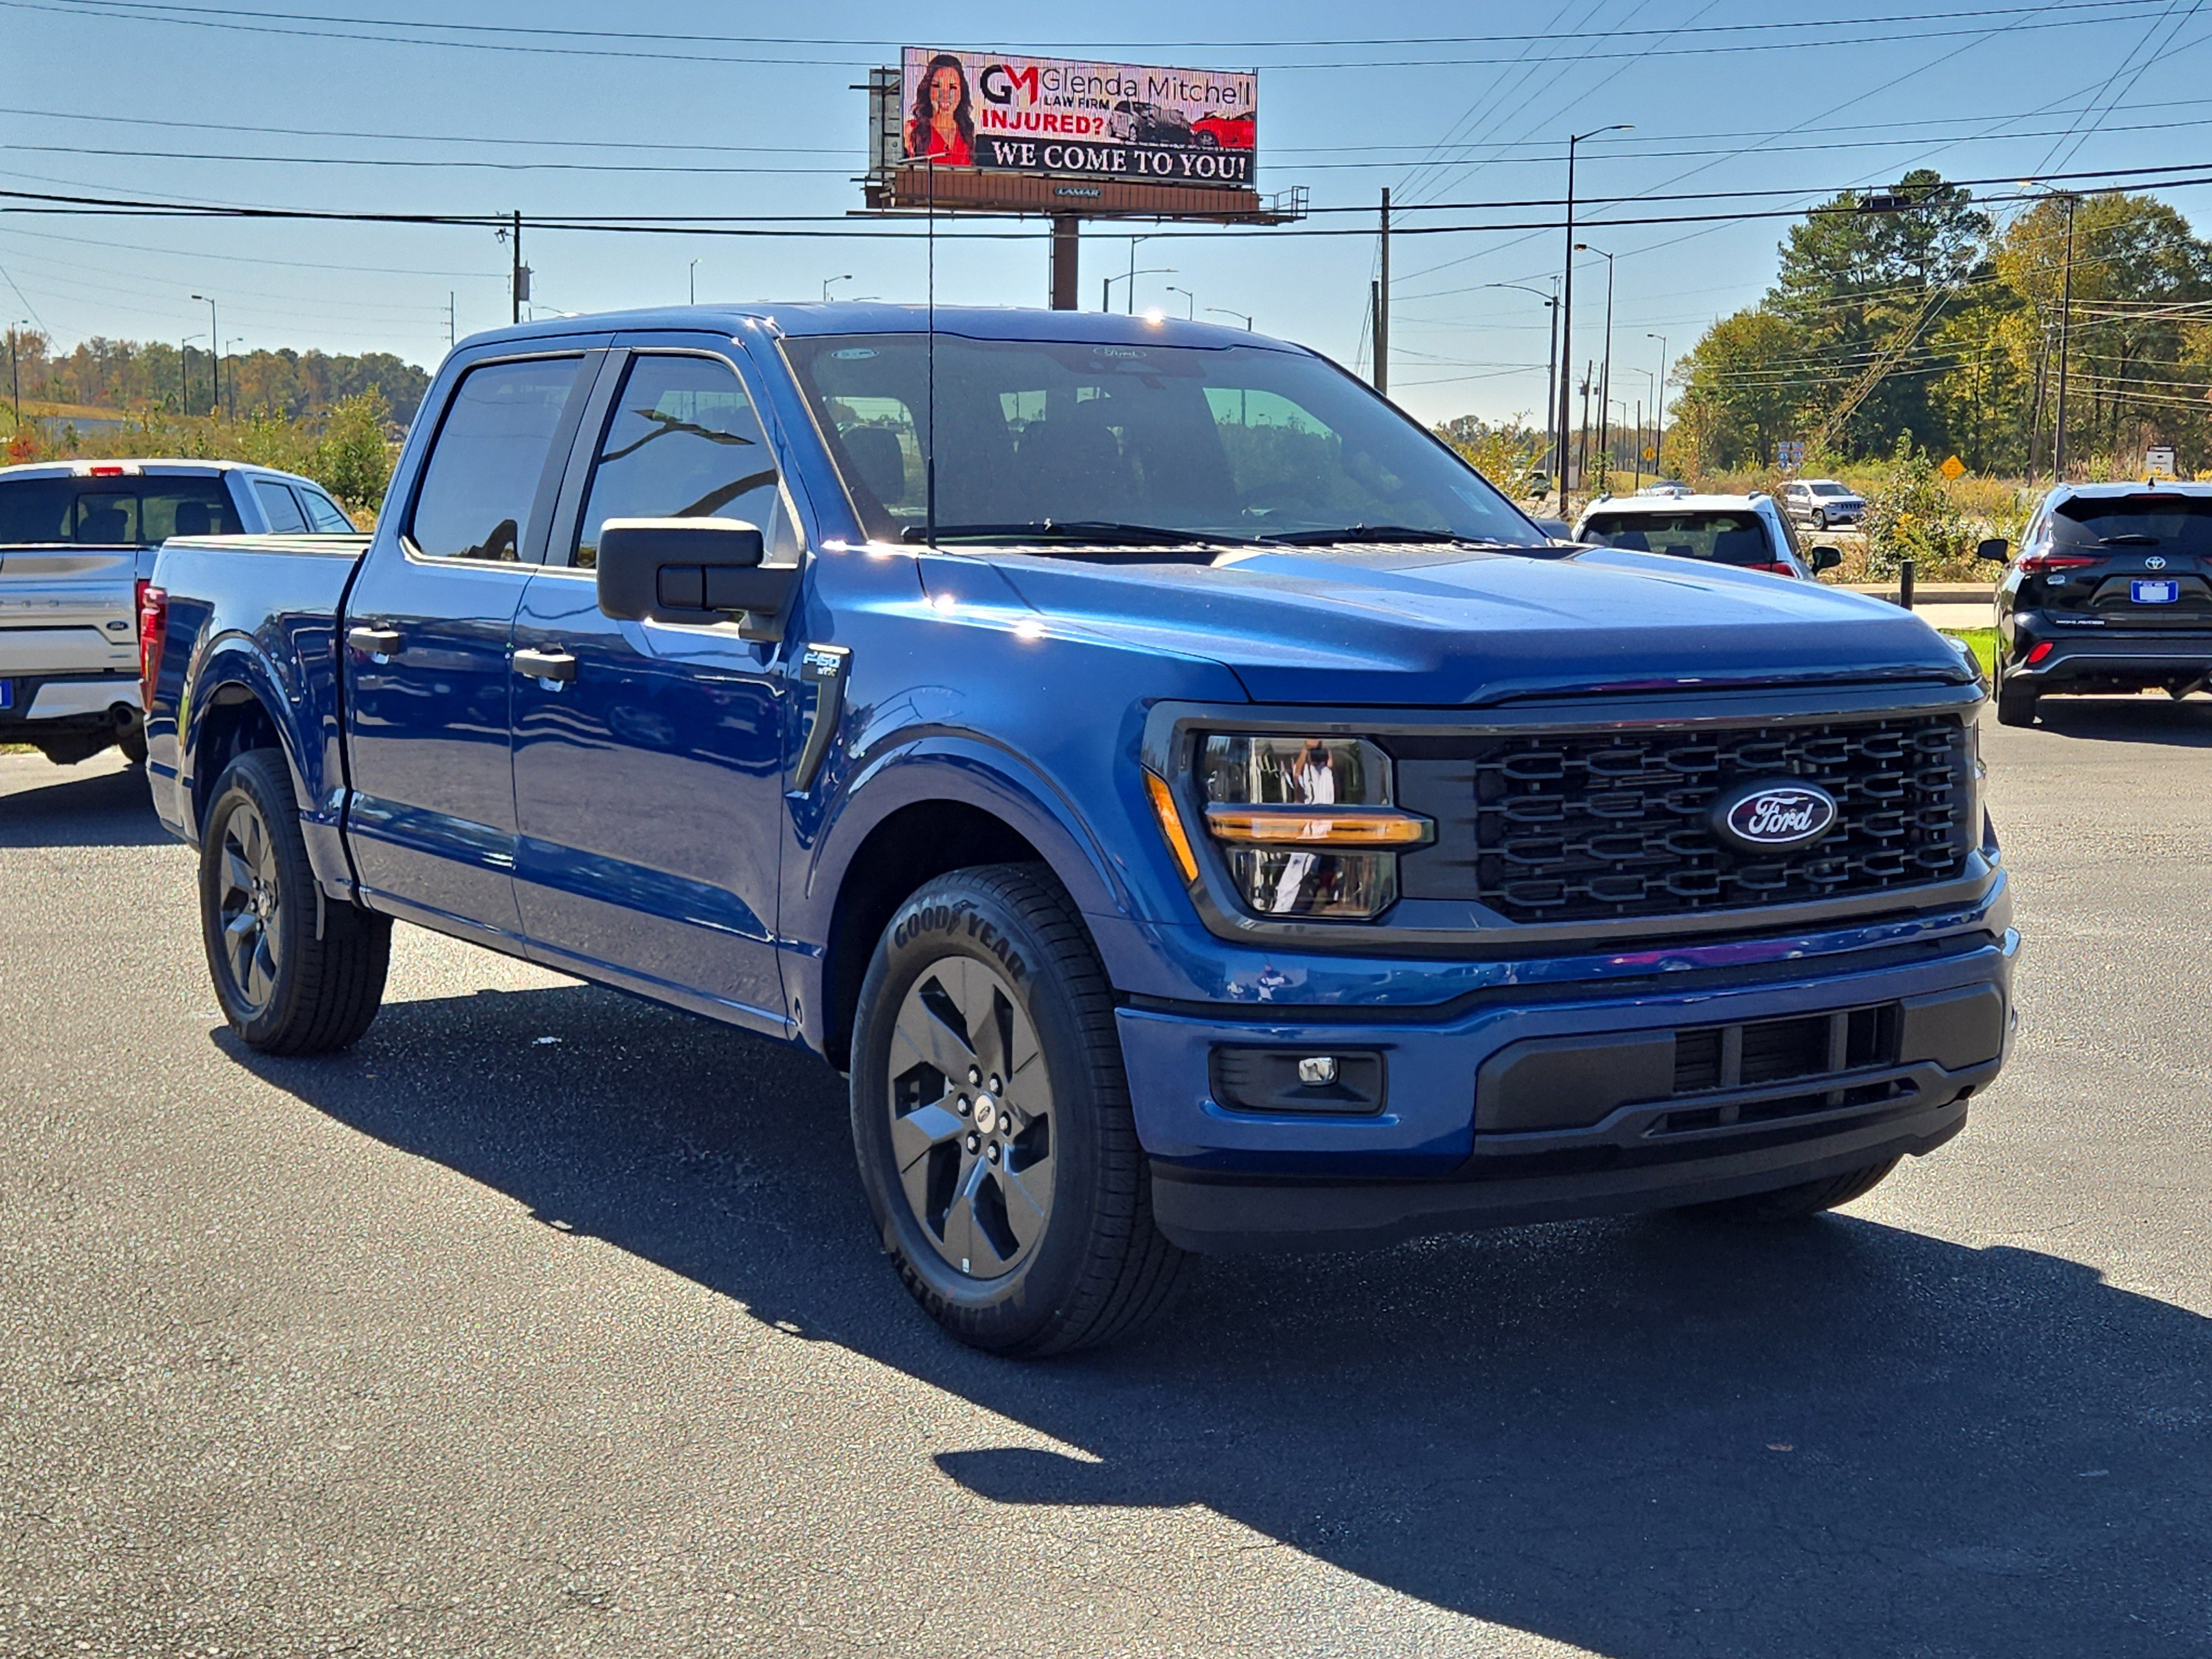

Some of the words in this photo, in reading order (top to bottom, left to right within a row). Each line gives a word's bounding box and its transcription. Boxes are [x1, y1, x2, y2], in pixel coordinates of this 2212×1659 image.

[980, 64, 1039, 105] GM
[1042, 68, 1137, 98] Glenda
[1148, 76, 1251, 106] Mitchell
[1044, 96, 1073, 107] LAW
[1078, 98, 1109, 110] FIRM
[982, 110, 1104, 135] INJURED?
[992, 141, 1036, 167] WE
[1044, 145, 1127, 172] COME
[1134, 150, 1173, 175] TO
[1179, 153, 1246, 179] YOU!
[1058, 188, 1099, 197] LAMAR
[1748, 797, 1814, 834] Ford
[895, 899, 1026, 983] GOODYEAR
